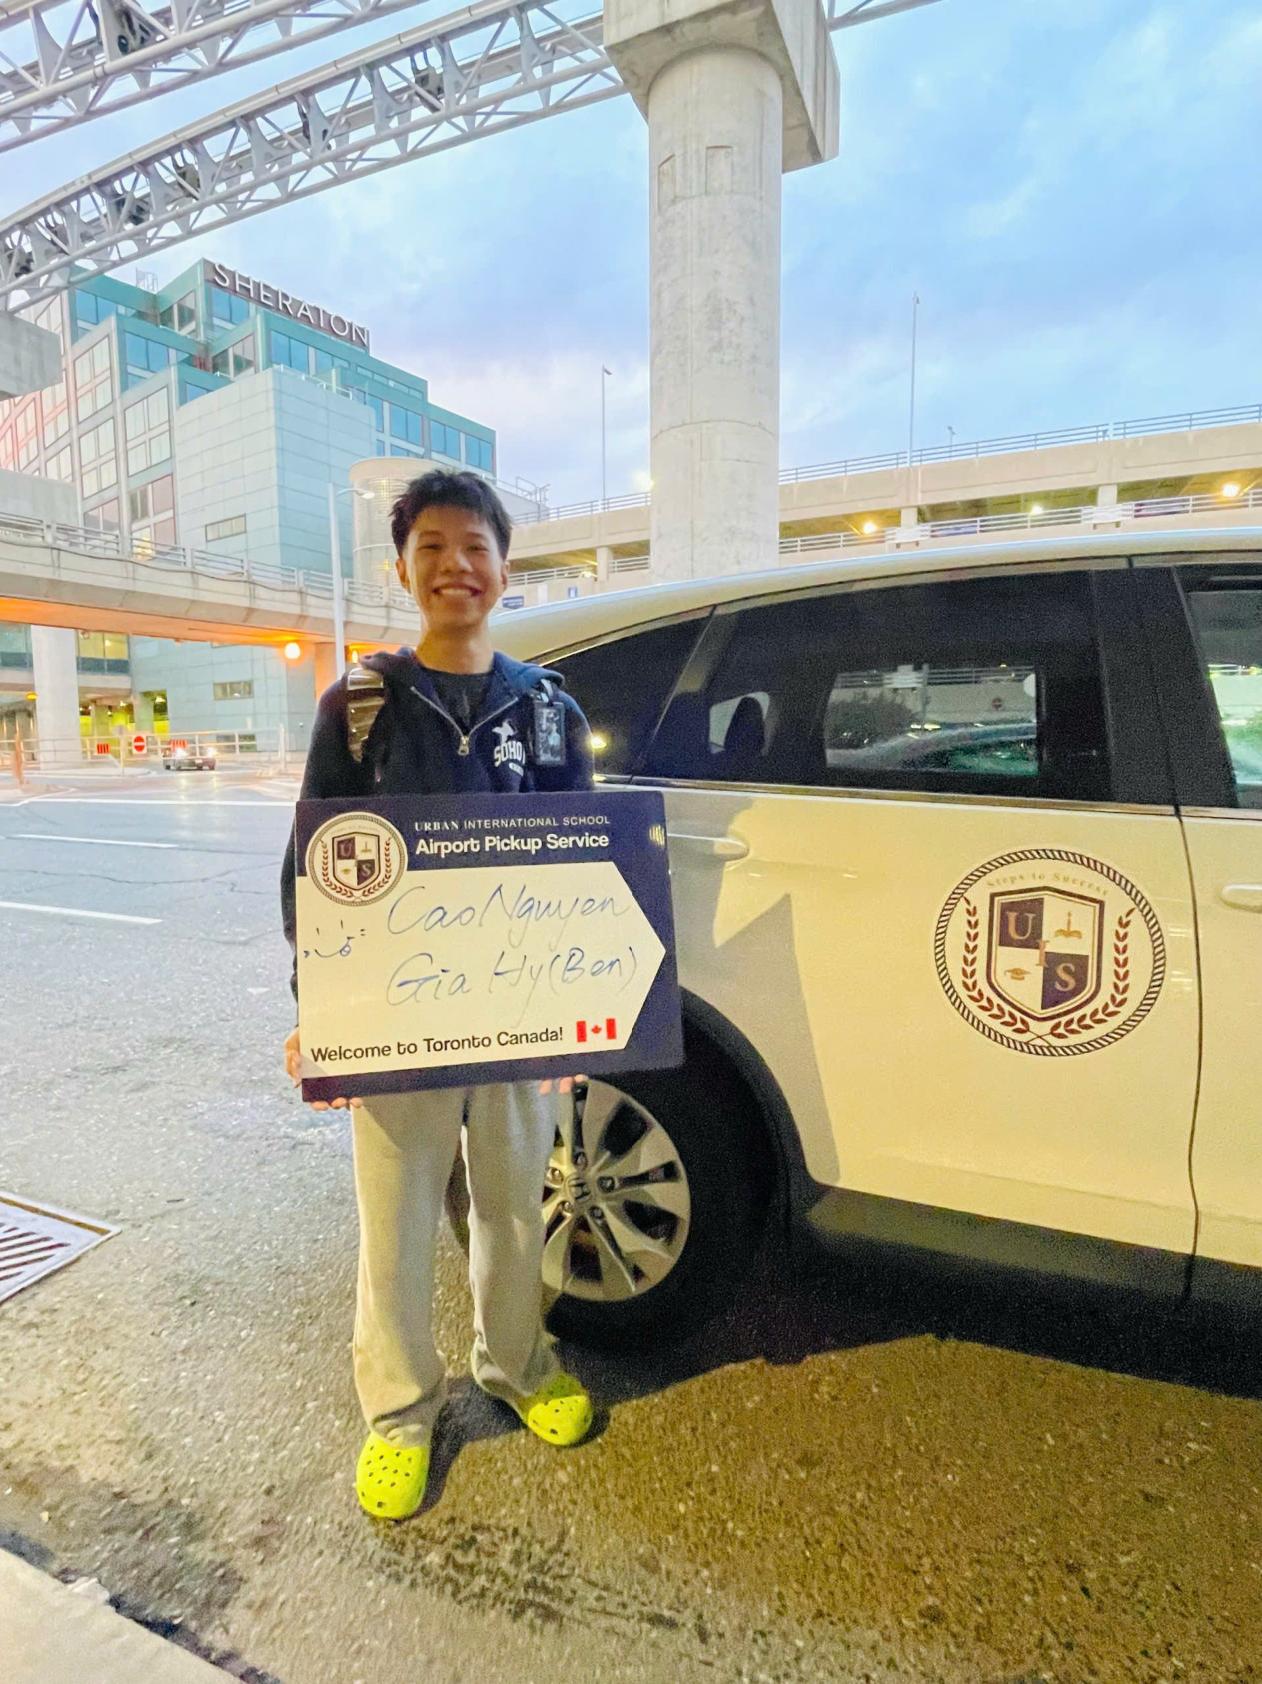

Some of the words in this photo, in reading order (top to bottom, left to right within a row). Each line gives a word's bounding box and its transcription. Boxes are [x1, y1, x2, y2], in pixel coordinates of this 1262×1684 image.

[214, 263, 369, 346] SHERATON
[415, 821, 459, 831] URBAN
[464, 817, 559, 829] INTERNATIONAL
[563, 815, 610, 826] SCHOOL
[415, 837, 480, 858] Airport
[484, 834, 542, 854] Pickup
[546, 832, 609, 849] Service
[479, 883, 630, 952] Nguyen
[1006, 911, 1036, 940] U
[1054, 962, 1076, 992] S
[386, 952, 471, 1006] Gia
[311, 1043, 391, 1062] Welcome
[397, 1041, 418, 1055] to
[424, 1035, 491, 1053] Toronto
[497, 1027, 563, 1046] Canada!
